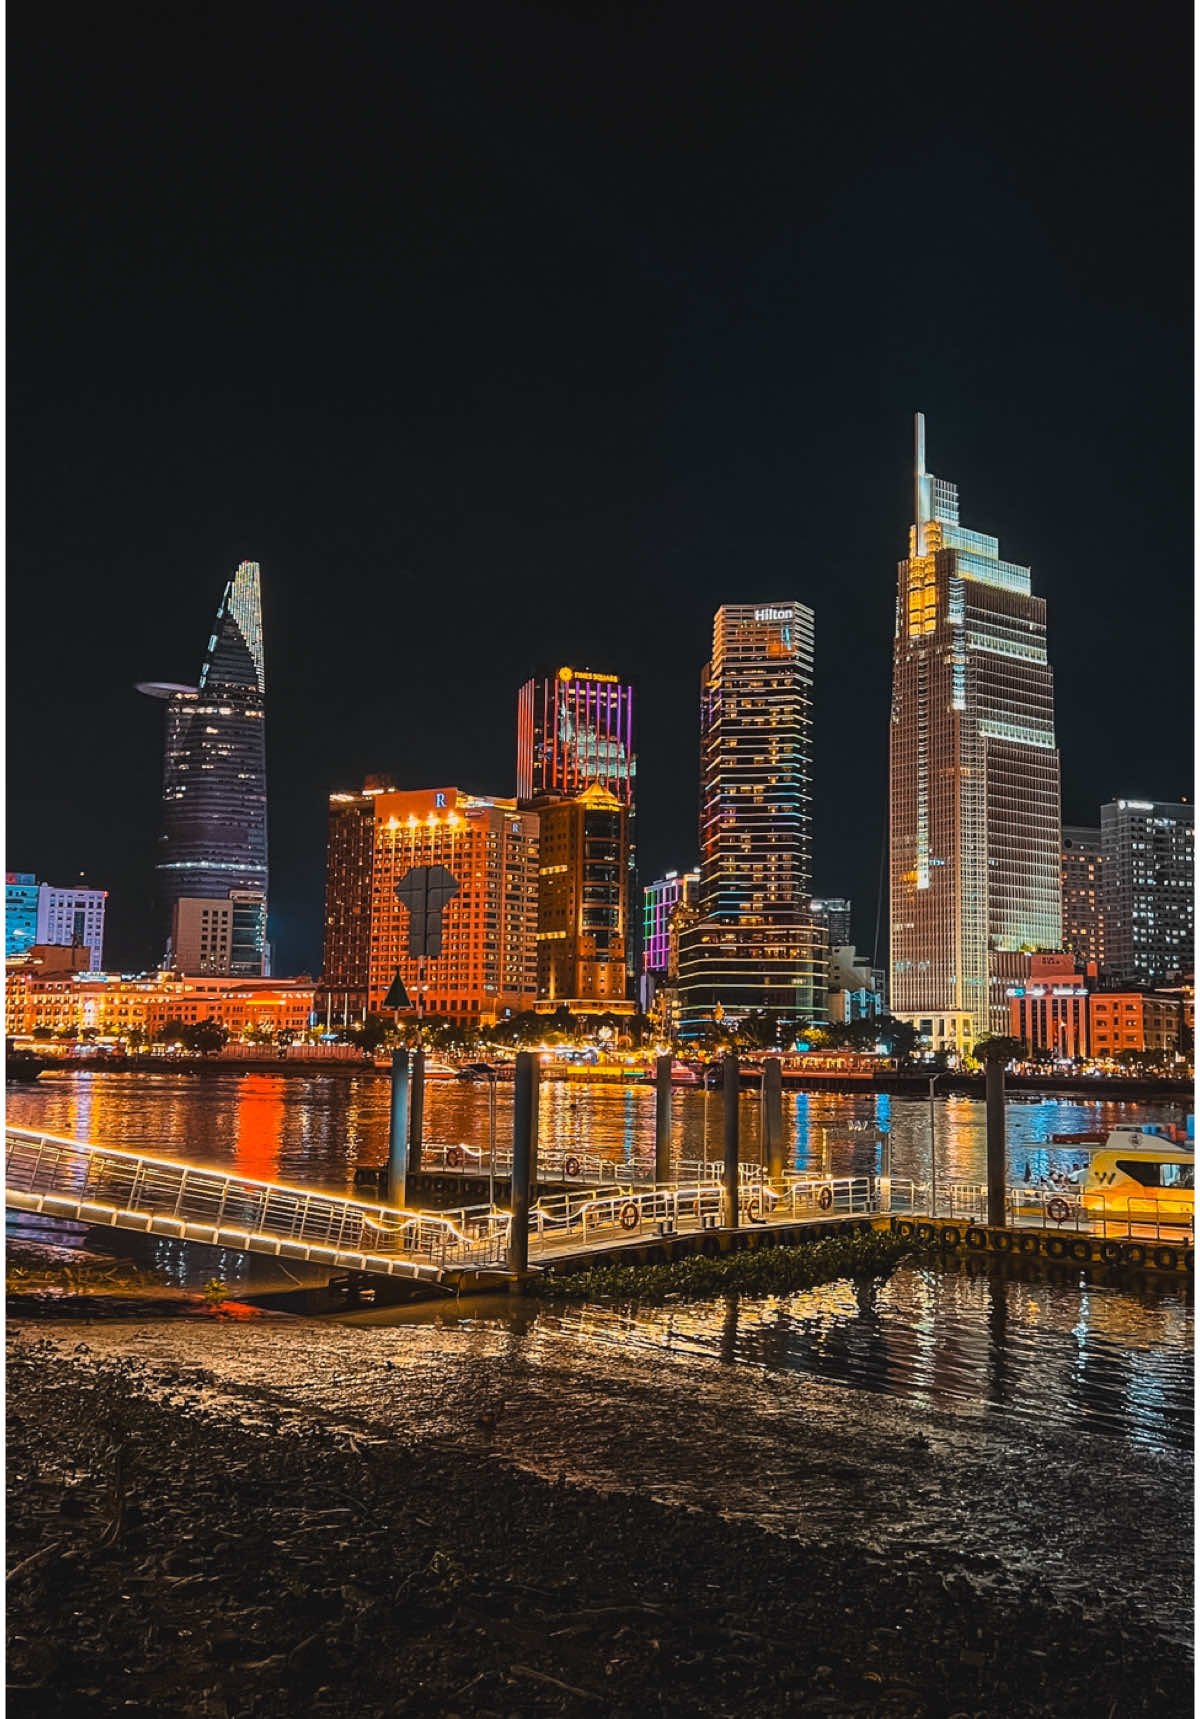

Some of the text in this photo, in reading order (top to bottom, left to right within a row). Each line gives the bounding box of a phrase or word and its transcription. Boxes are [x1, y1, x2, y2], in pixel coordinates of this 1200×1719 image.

[755, 608, 793, 621] Hilton
[435, 792, 447, 808] R
[512, 823, 519, 833] R
